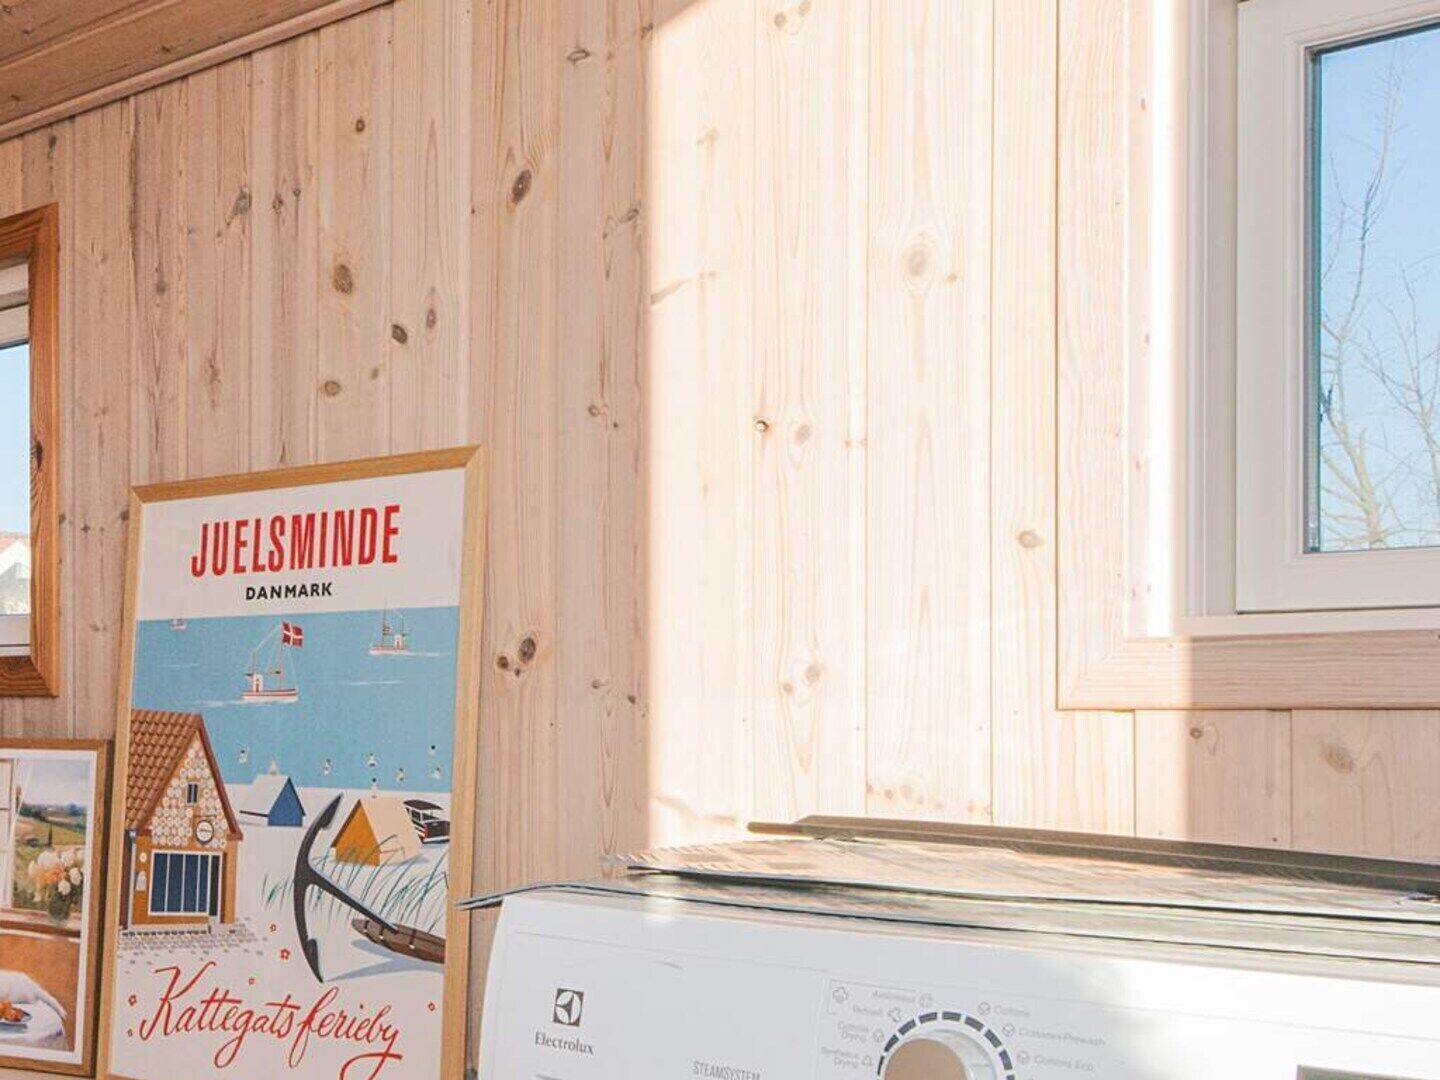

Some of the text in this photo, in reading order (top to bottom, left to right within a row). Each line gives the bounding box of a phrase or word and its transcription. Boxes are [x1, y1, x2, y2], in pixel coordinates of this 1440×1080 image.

[191, 505, 400, 577] JUELSMINDE
[245, 582, 334, 600] DANMARK
[140, 961, 300, 1068] Kattegats
[534, 1031, 594, 1055] Electrolux
